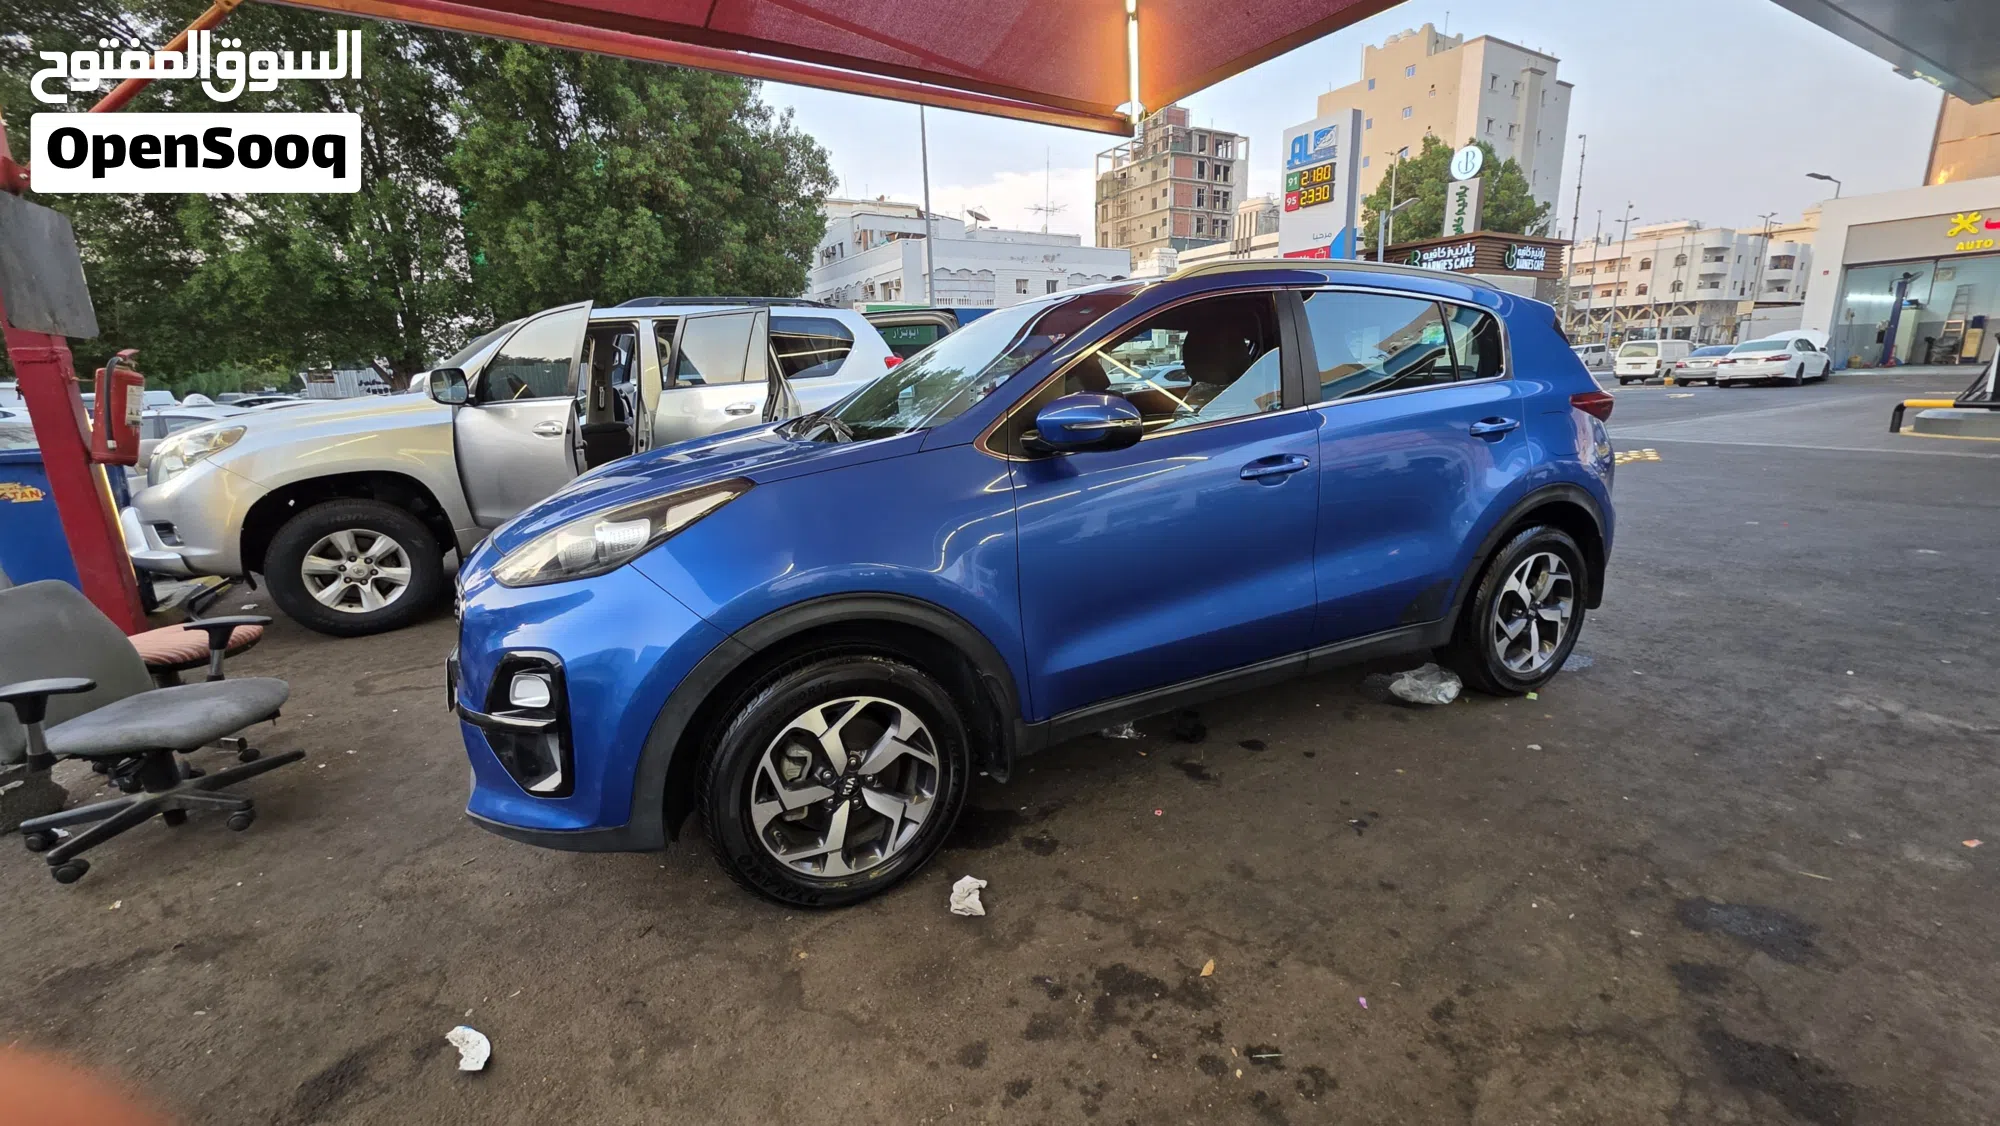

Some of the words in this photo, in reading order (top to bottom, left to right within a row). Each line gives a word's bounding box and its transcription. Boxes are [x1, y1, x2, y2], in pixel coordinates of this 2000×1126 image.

[1288, 176, 1298, 187] 91
[1286, 196, 1297, 207] 95
[1313, 232, 1332, 241] مرحبا
[1446, 242, 1476, 258] بارنيز
[1956, 238, 1994, 251] AUTO
[842, 777, 856, 795] KIA
